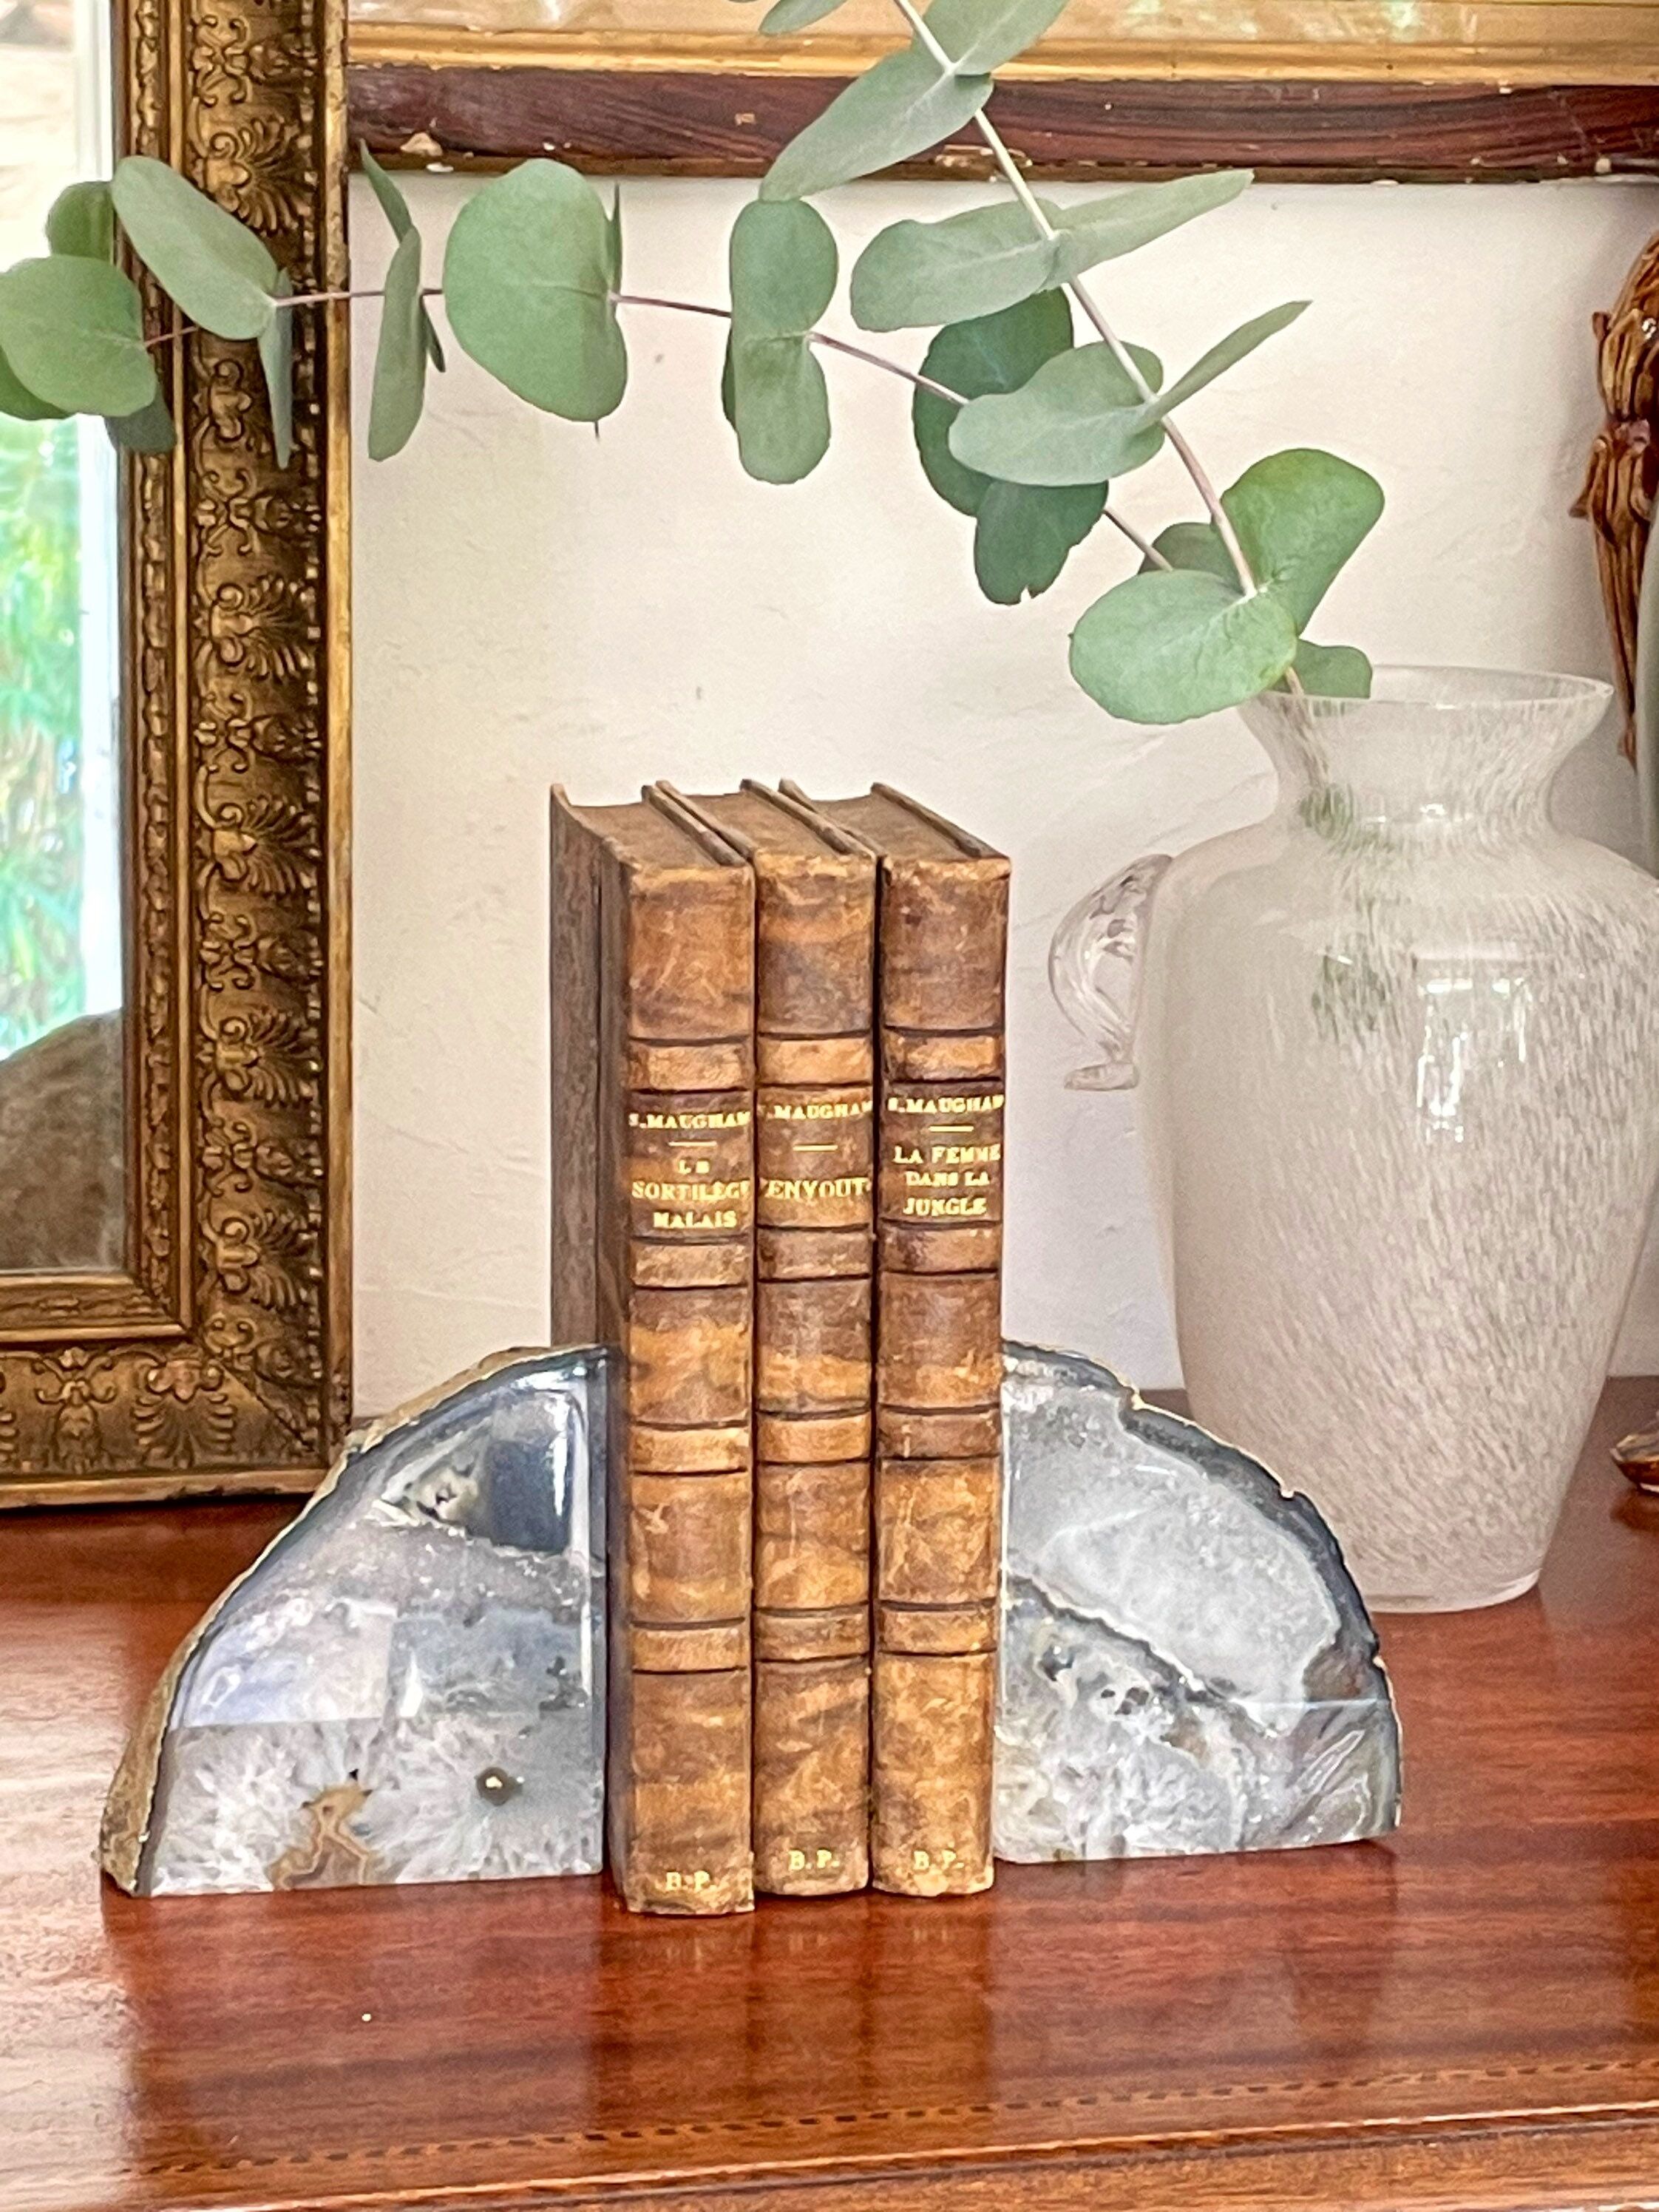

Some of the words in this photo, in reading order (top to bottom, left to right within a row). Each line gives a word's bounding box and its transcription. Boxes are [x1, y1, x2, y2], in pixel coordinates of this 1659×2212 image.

[893, 1146, 923, 1164] LA
[932, 1144, 1001, 1164] FEMME
[905, 1170, 958, 1187] DANS
[965, 1172, 990, 1186] LA
[903, 1197, 987, 1216] JUNGLE
[654, 1211, 737, 1227] MALAIS
